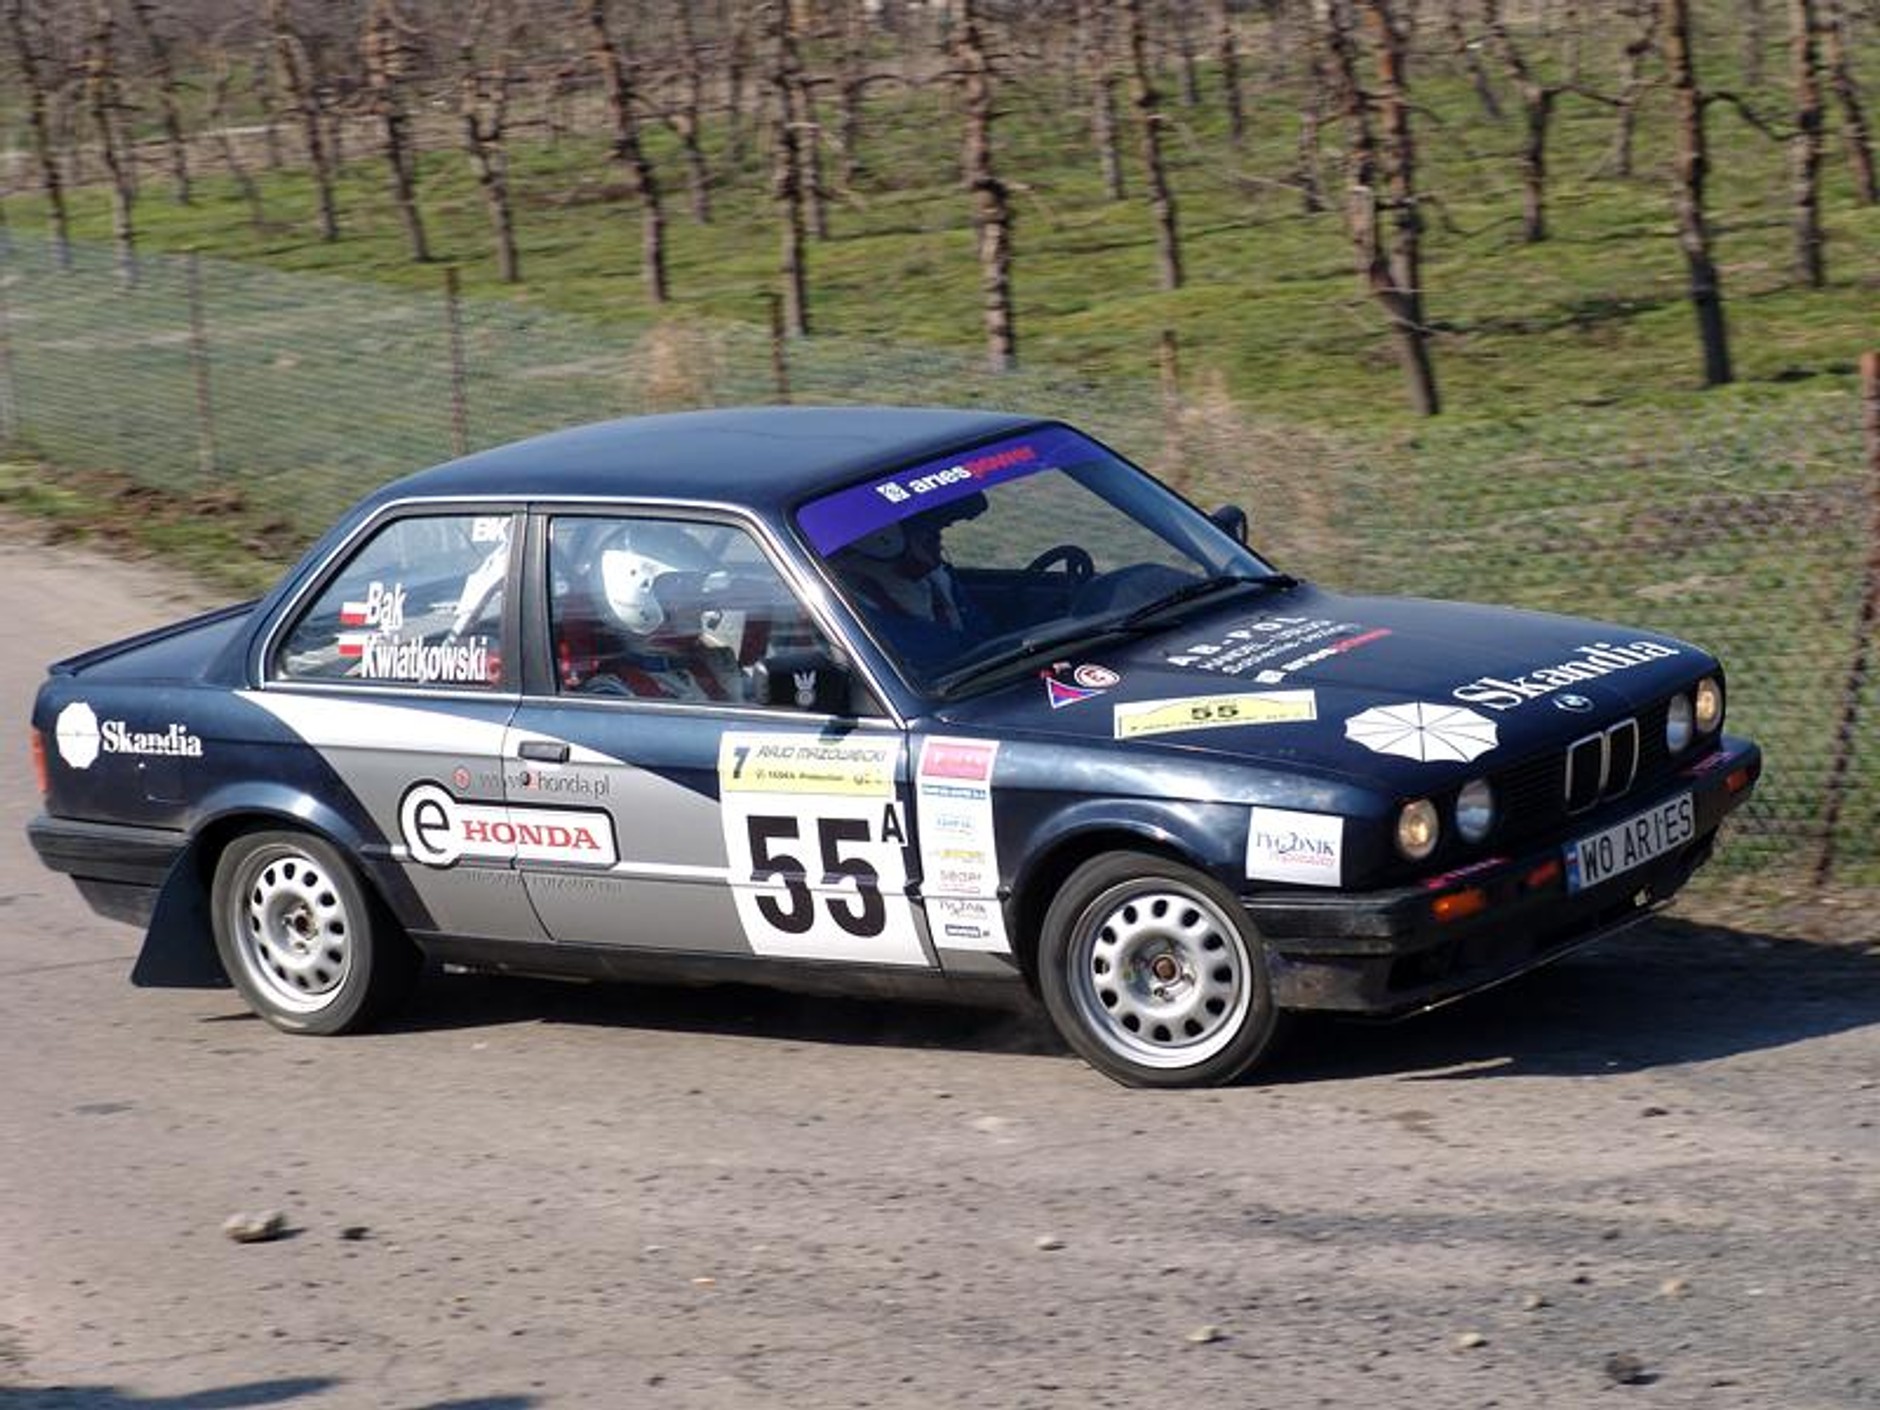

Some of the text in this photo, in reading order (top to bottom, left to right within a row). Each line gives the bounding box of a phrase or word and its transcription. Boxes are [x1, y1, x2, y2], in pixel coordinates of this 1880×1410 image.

[361, 634, 488, 684] Kwiatkowski
[1453, 640, 1680, 710] Skandia
[100, 720, 203, 757] Skandia
[461, 820, 601, 850] HONDA
[1624, 799, 1693, 867] ARIES
[747, 803, 905, 938] 55 A
